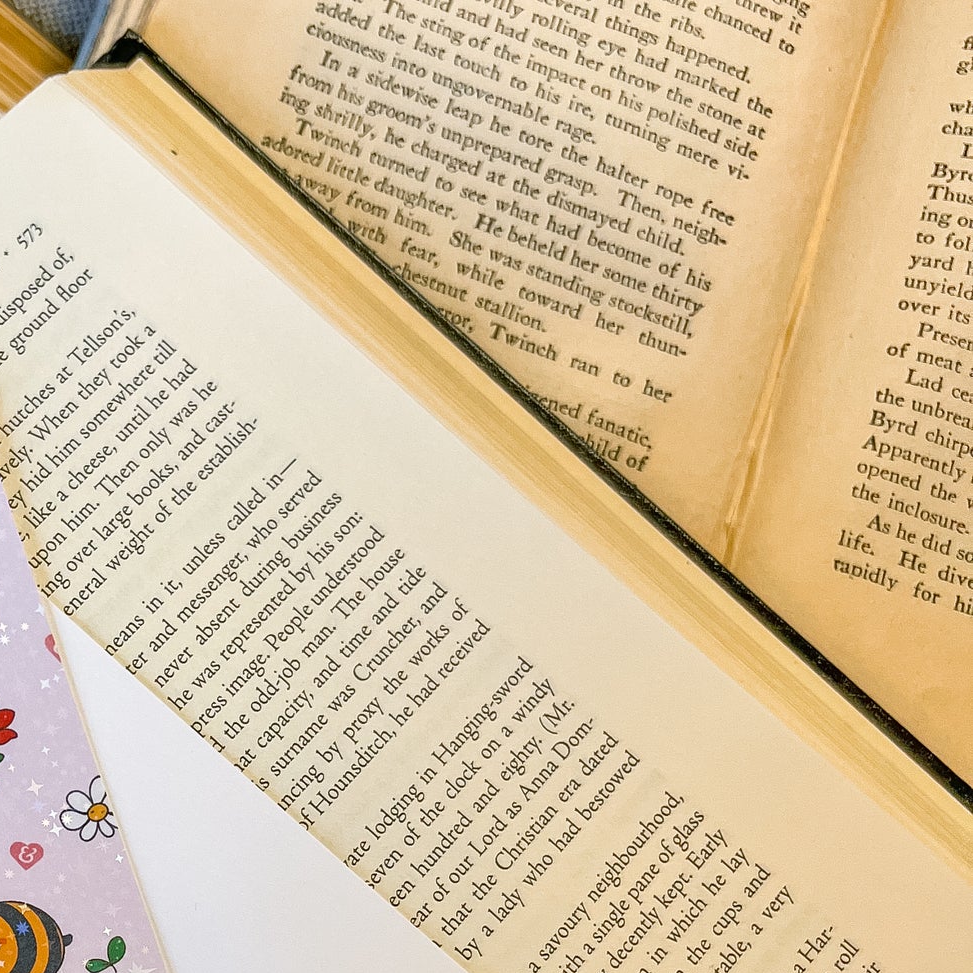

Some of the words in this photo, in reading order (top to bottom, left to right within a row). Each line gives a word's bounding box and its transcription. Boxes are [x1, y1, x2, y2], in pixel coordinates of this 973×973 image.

[305, 20, 387, 64] ciousness
[390, 51, 429, 79] into
[431, 70, 551, 127] ungovernable
[318, 48, 343, 73] In
[346, 65, 361, 80] a
[364, 69, 439, 110] sidewise
[443, 97, 485, 130] leap
[488, 114, 512, 138] he
[517, 129, 554, 154] tore
[560, 143, 590, 167] the
[594, 154, 650, 190] halter
[654, 183, 695, 210] rope
[700, 198, 736, 228] free
[15, 222, 44, 251] 573
[448, 229, 484, 257] She
[488, 248, 524, 272] was
[525, 264, 607, 308] standing
[55, 365, 74, 385] at
[65, 309, 137, 367] Tellson's,
[489, 320, 559, 363] Twinch
[569, 356, 600, 378] ran
[611, 371, 632, 389] to
[641, 378, 674, 404] her
[885, 342, 912, 359] of
[915, 350, 964, 375] meat
[860, 434, 968, 484] Apparently
[851, 482, 882, 505] the
[153, 646, 194, 689] never
[195, 597, 242, 646] absent
[238, 549, 292, 598] during
[280, 492, 343, 550] business
[269, 713, 330, 778] surname
[326, 683, 357, 713] was
[352, 616, 422, 682] Cruncher,
[419, 580, 449, 616] and
[363, 783, 426, 841] lodging
[415, 767, 439, 786] in
[430, 655, 535, 768] Hanging-sword
[409, 809, 474, 879] hundred
[472, 778, 501, 814] and
[499, 735, 543, 782] eighty.
[538, 699, 576, 736] (Mr.
[573, 748, 642, 822] bestowed
[547, 816, 583, 854] had
[521, 853, 555, 887] who
[480, 924, 495, 938] a
[486, 887, 526, 924] lady
[453, 936, 484, 962] by
[796, 925, 834, 965] Har-
